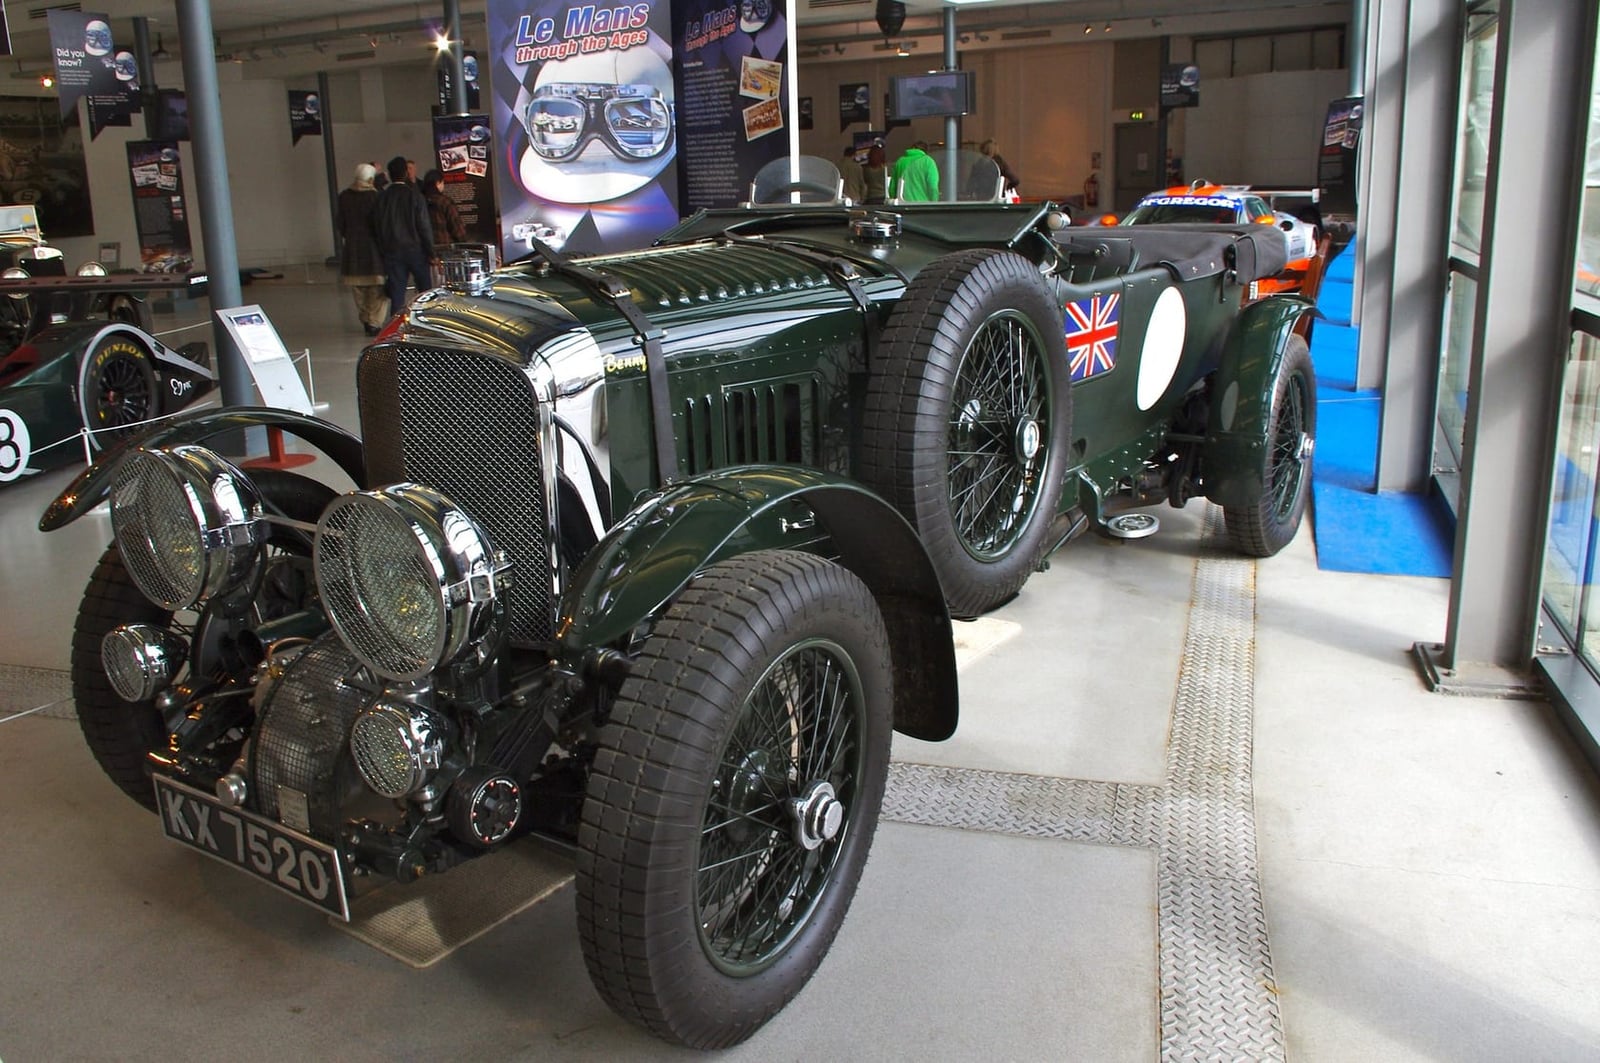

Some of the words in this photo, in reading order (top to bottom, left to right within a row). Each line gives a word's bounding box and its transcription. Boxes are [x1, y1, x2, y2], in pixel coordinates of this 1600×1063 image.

[515, 15, 555, 47] Le
[563, 3, 649, 39] Mans
[685, 21, 700, 41] Le
[56, 48, 70, 57] Did
[70, 50, 85, 59] you
[515, 40, 577, 63] through
[581, 36, 607, 52] the
[609, 30, 648, 49] Ages
[58, 58, 82, 67] know?
[96, 343, 145, 366] DUNLOP
[162, 787, 219, 851] KX
[218, 810, 329, 900] 7520
